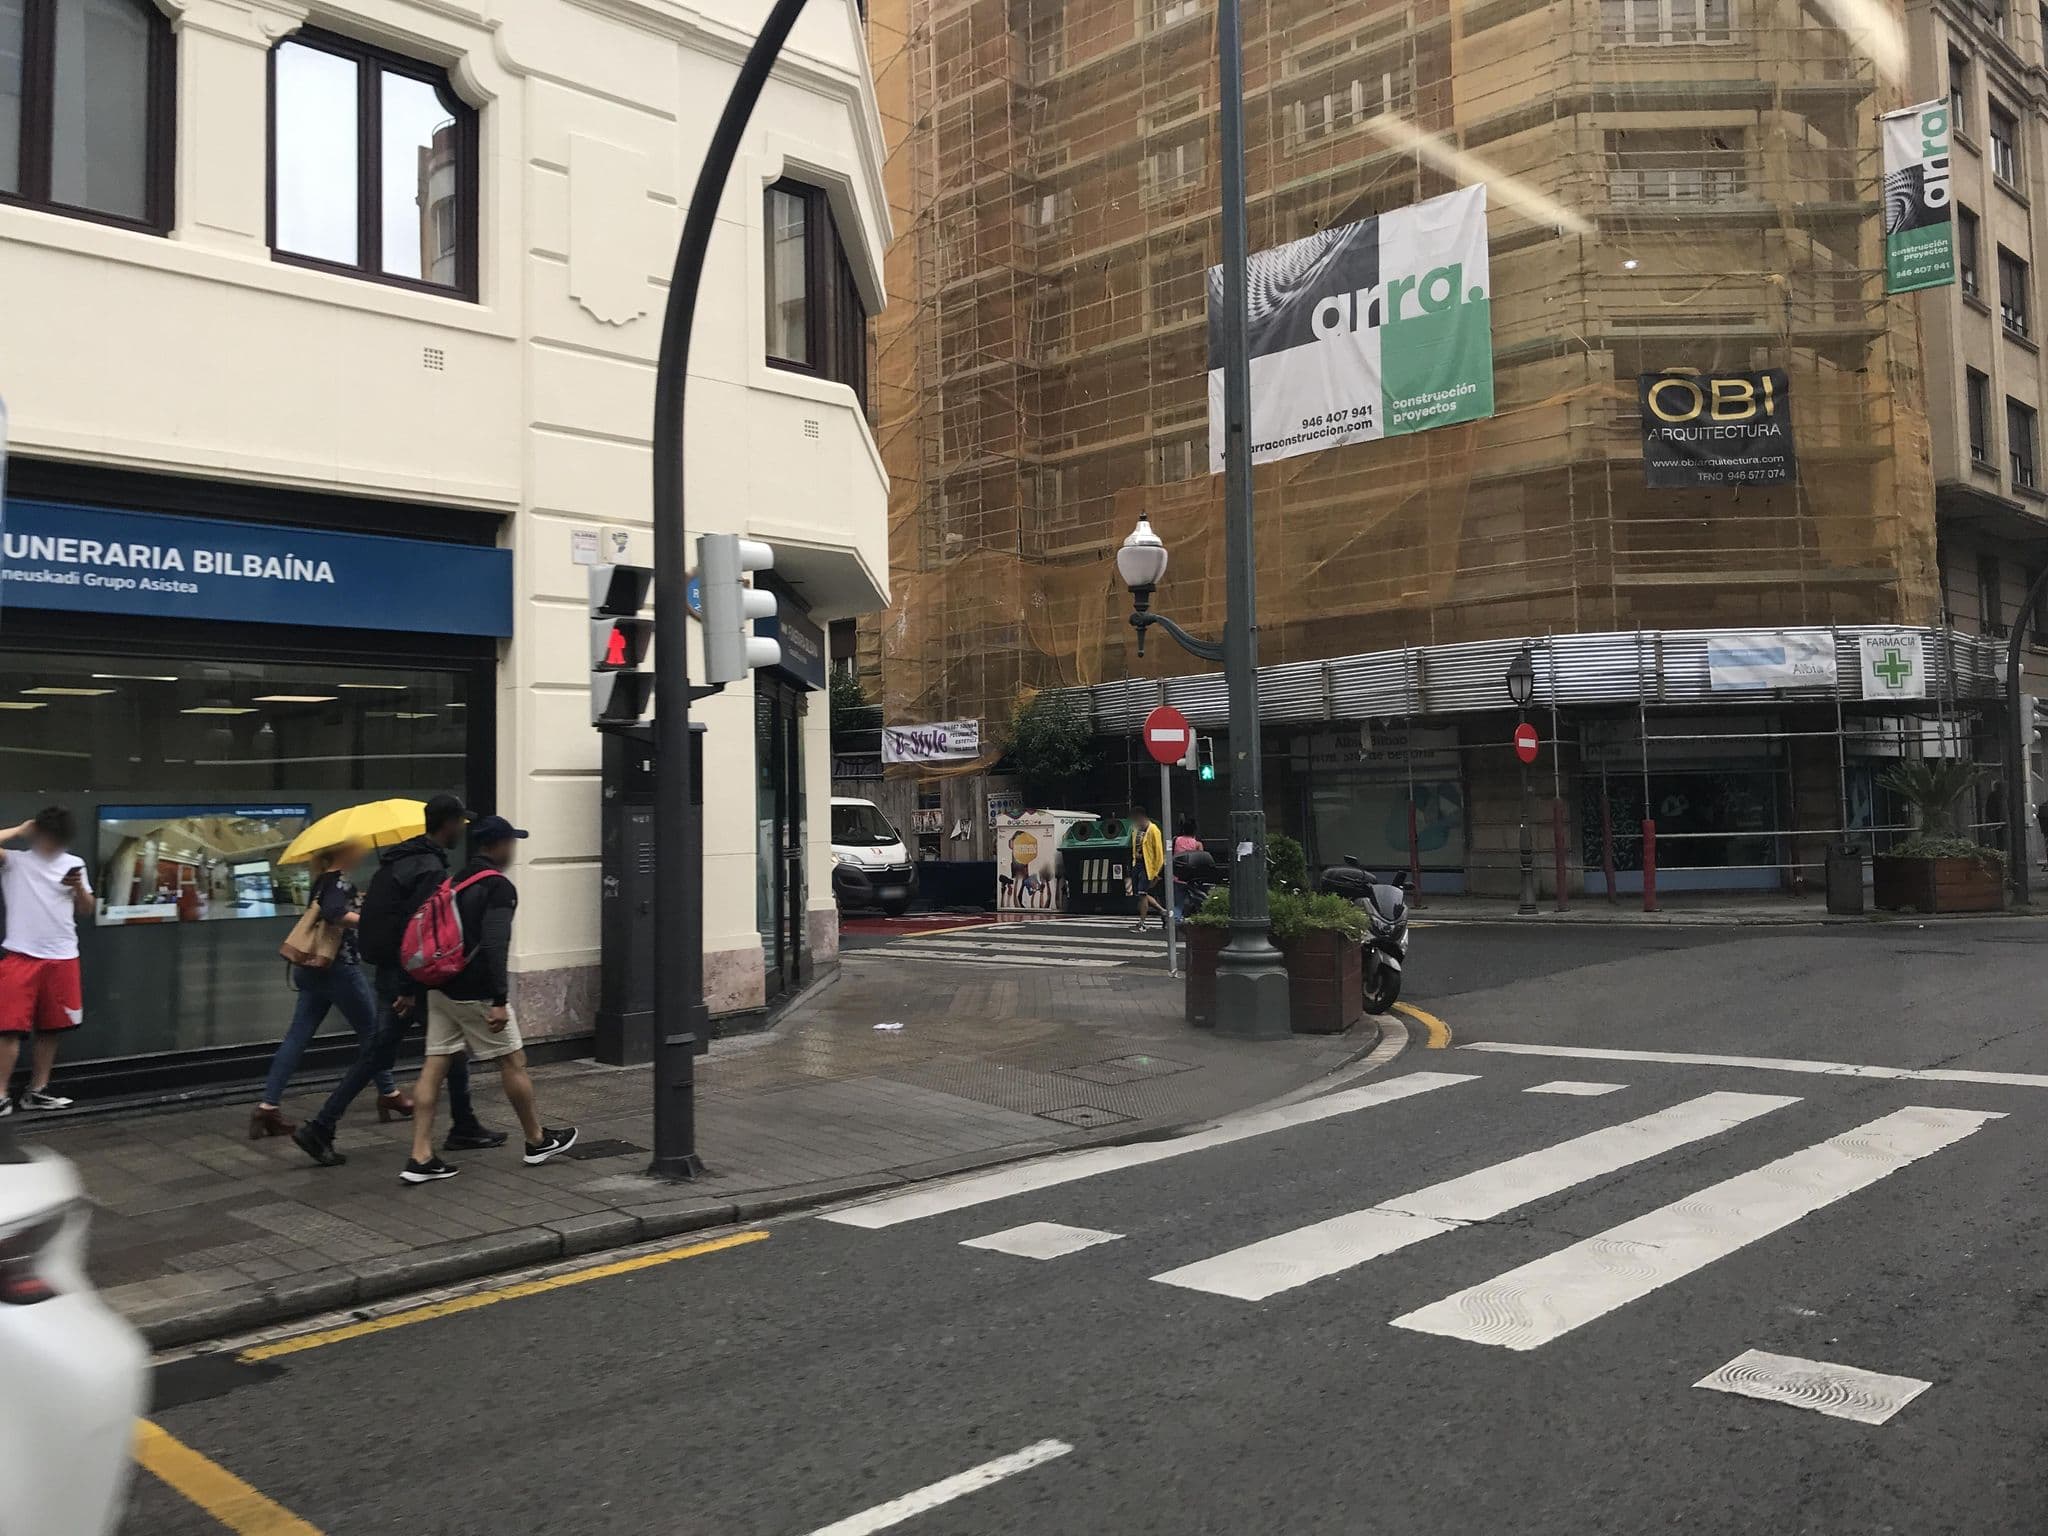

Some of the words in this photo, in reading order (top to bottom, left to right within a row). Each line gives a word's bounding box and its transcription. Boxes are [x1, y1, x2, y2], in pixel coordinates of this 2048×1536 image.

[1903, 247, 1949, 262] proyectos
[1913, 265, 1932, 275] 407
[1392, 382, 1477, 410] construcción
[1301, 415, 1323, 430] 946
[1326, 409, 1348, 424] 407
[1349, 404, 1373, 420] 941
[1392, 400, 1457, 425] proyectos
[1648, 424, 1782, 442] ARQUITECTURA
[1748, 470, 1765, 480] 577
[193, 550, 335, 584] BILBAÍNA
[83, 572, 136, 591] Grupo
[139, 577, 198, 594] Asistea
[1866, 637, 1916, 648] FARMACIA
